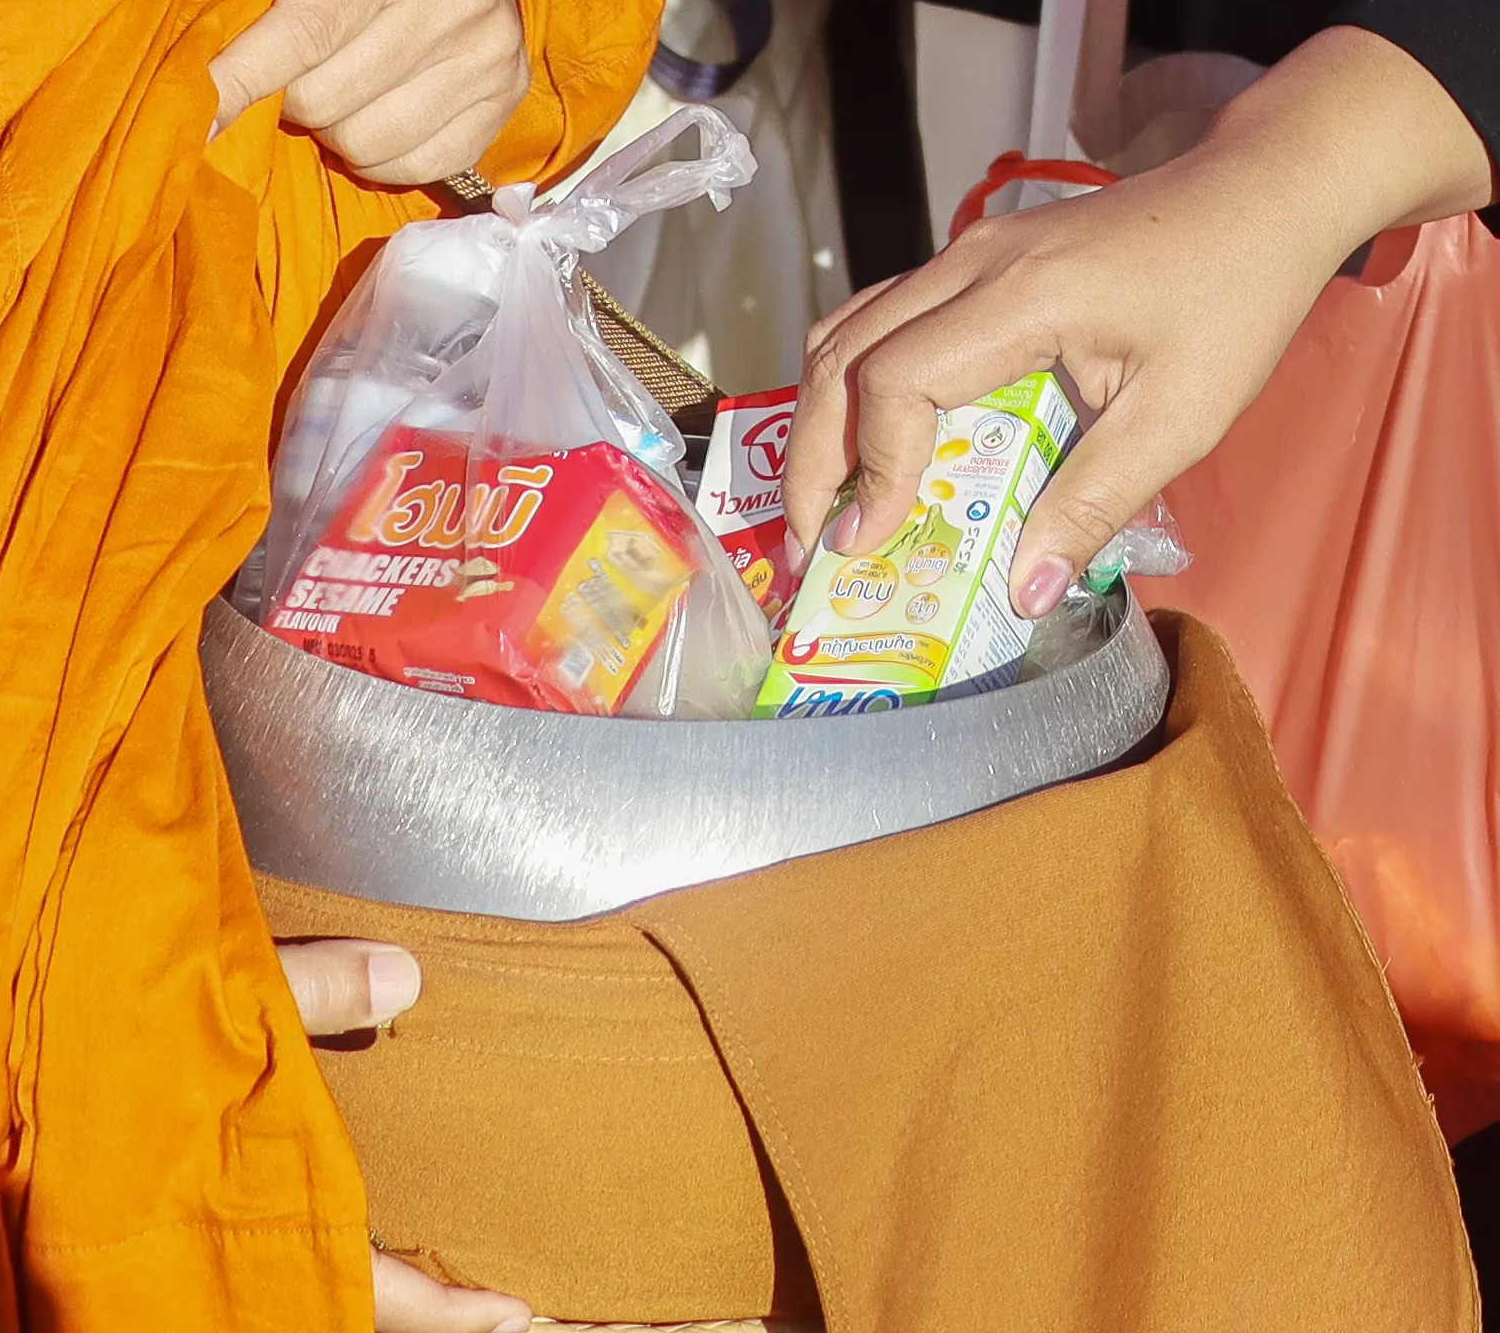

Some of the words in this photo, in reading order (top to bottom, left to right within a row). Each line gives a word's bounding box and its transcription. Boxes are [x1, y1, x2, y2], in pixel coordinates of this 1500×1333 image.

[303, 547, 461, 588] CRACKERS
[953, 526, 980, 574] おいしい
[285, 579, 406, 616] SESAME
[272, 610, 342, 634] FLAVOUR
[819, 633, 916, 660] จมูกข้าวญี่ปุ่น
